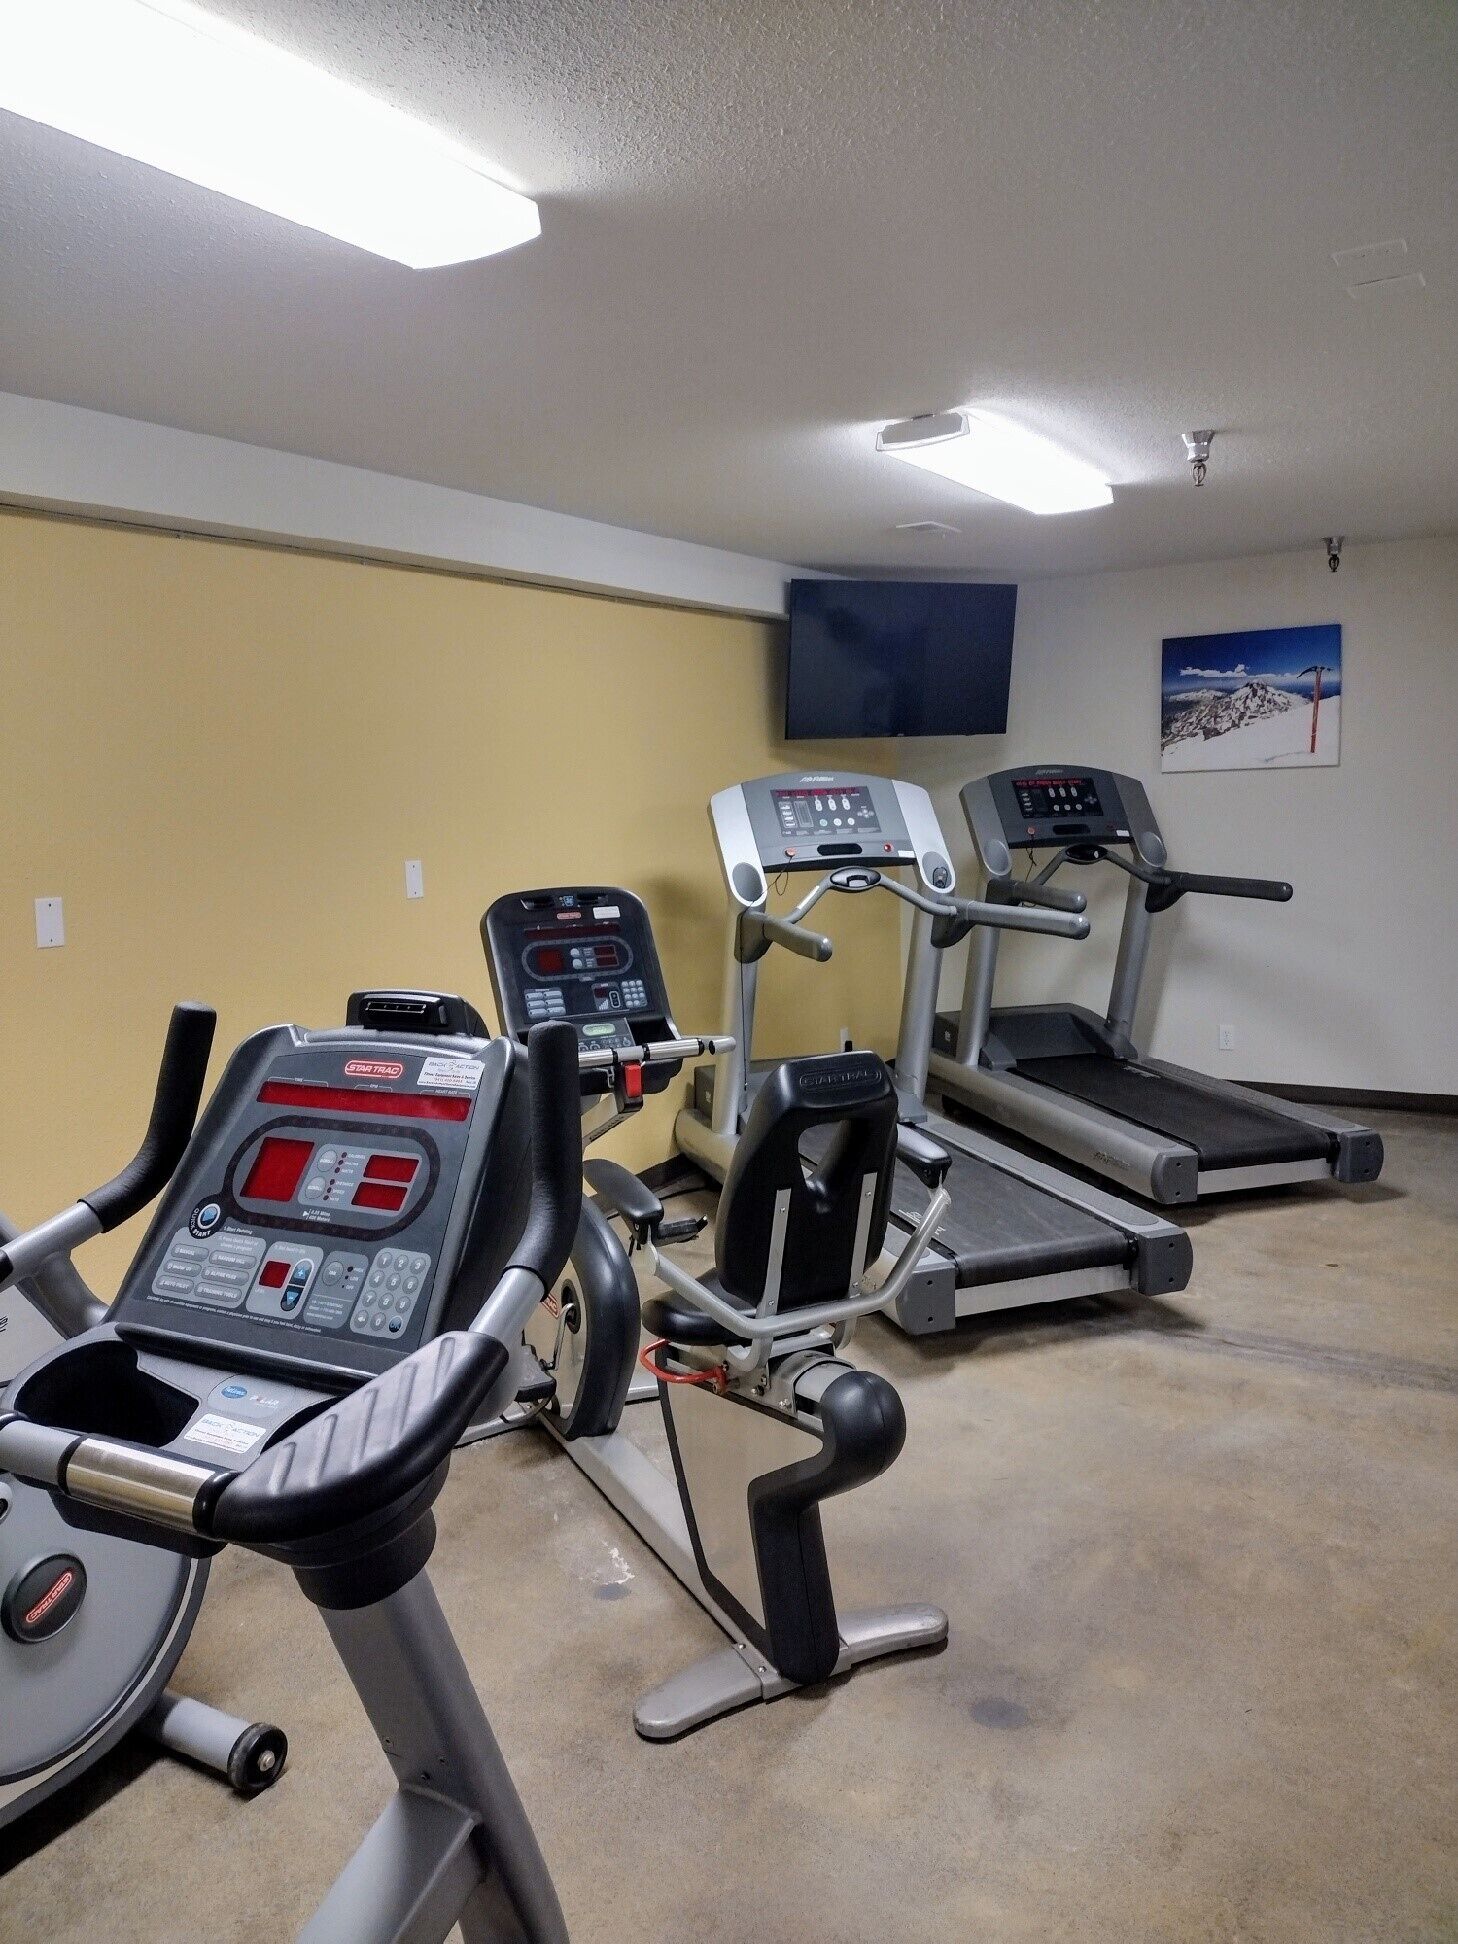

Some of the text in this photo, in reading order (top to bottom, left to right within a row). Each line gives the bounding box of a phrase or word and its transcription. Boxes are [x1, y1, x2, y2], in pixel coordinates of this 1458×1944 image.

[348, 1063, 400, 1075] STAR TRAC
[190, 1207, 200, 1231] QUICK
[192, 1228, 211, 1238] START
[414, 1262, 421, 1270] 3
[374, 1275, 380, 1283] 4
[366, 1294, 406, 1309] 7 8 9
[375, 1317, 381, 1326] 0
[30, 1575, 70, 1619] STAR TRAC
